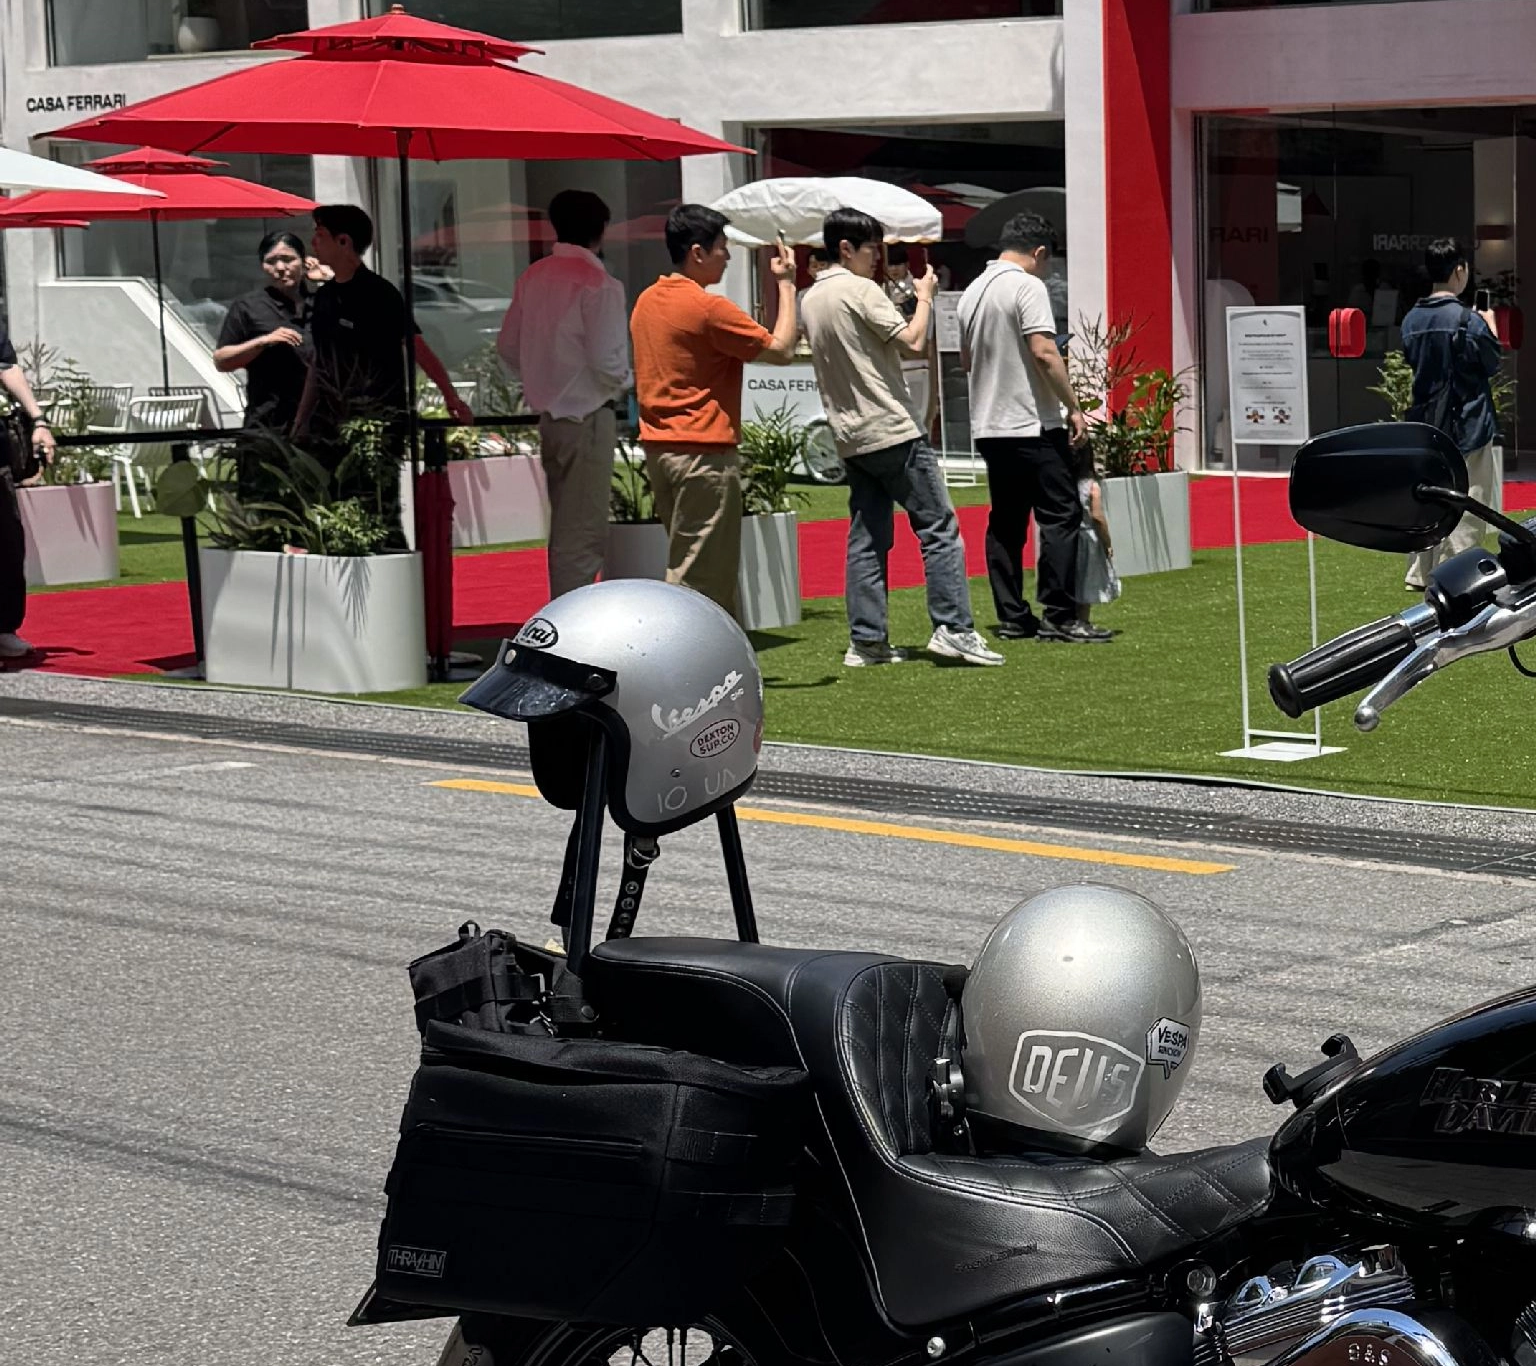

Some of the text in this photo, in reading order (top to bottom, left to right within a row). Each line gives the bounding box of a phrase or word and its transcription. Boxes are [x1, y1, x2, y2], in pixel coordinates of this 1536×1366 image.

[26, 93, 126, 113] CASA FERRARI
[748, 379, 786, 391] CASA
[1158, 1027, 1187, 1050] VESPA
[1022, 1046, 1131, 1110] DEUS
